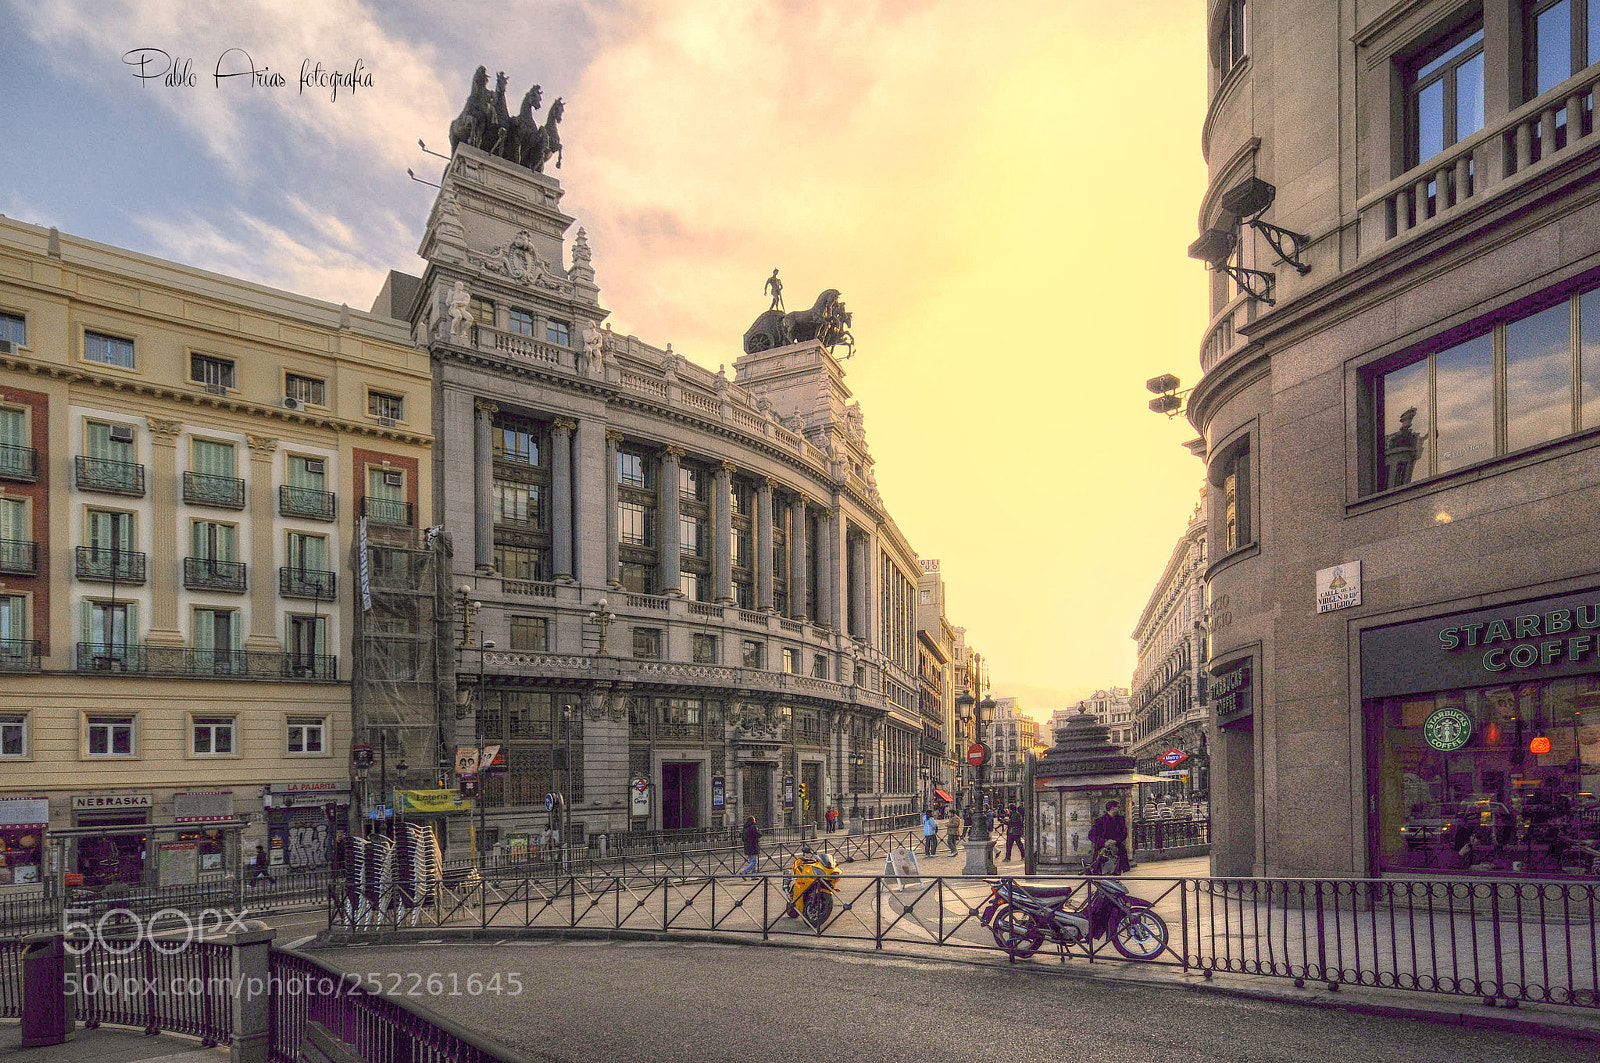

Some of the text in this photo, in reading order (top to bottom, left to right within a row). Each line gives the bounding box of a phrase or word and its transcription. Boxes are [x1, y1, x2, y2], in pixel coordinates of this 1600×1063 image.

[1438, 604, 1600, 650] STARBU
[1482, 633, 1600, 672] COFF
[1426, 710, 1469, 730] STARBUCKS
[1431, 738, 1463, 749] COFFEE
[77, 797, 148, 807] NEBRASKA
